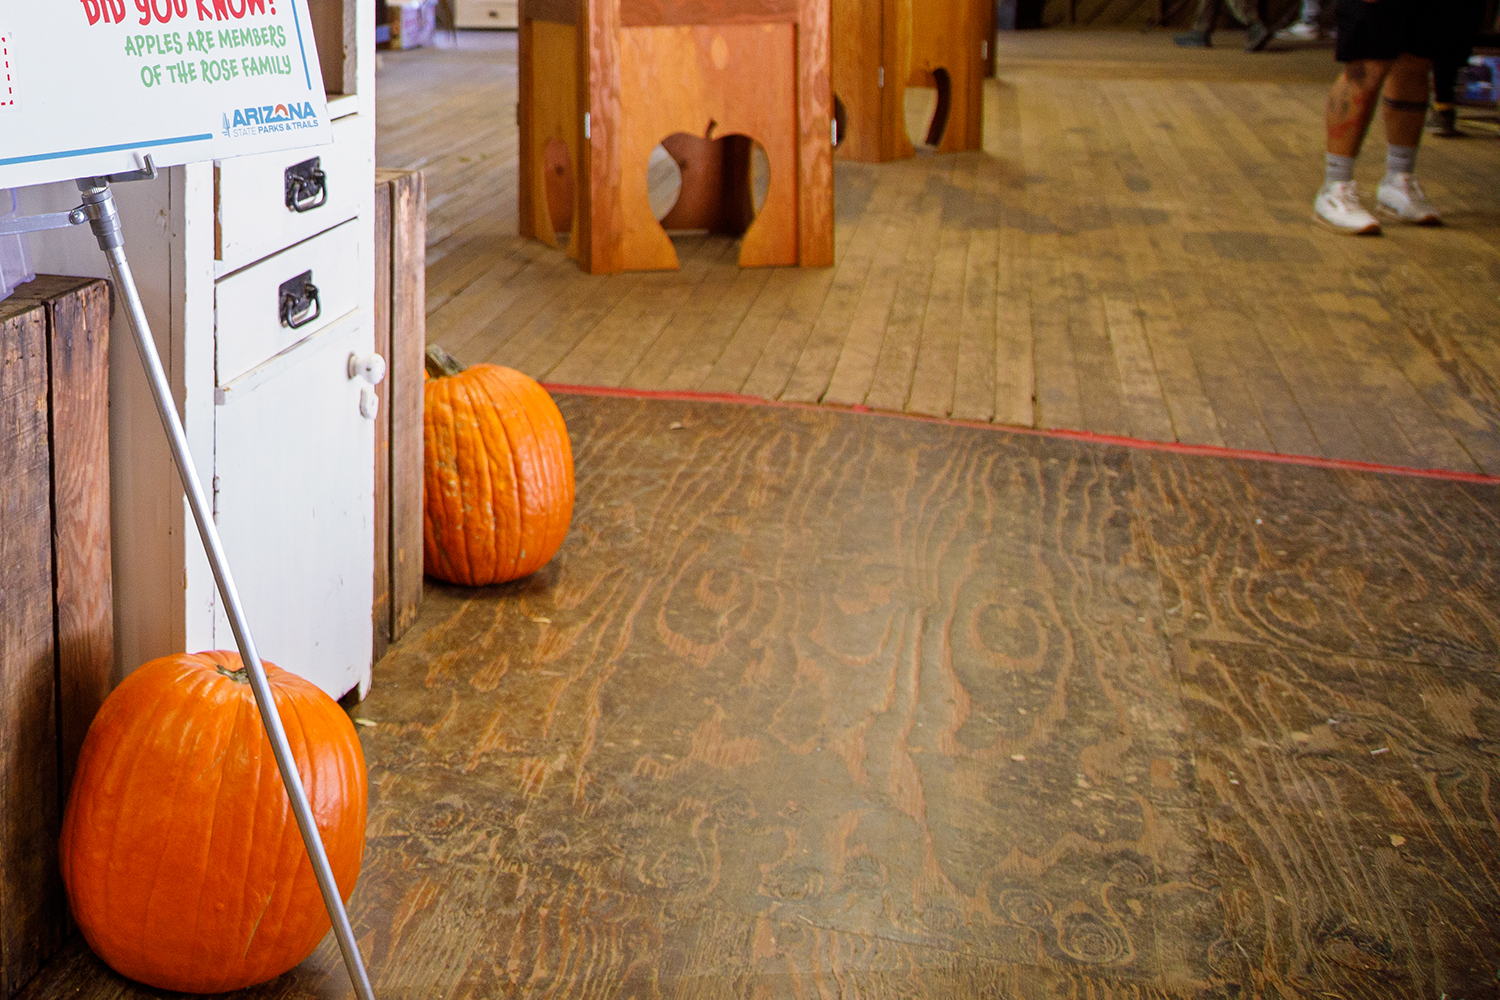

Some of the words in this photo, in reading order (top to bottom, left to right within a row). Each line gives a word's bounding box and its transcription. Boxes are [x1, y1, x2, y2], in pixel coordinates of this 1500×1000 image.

[124, 31, 184, 57] APPLES
[186, 28, 215, 55] ARE
[218, 24, 288, 50] MEMBERS
[141, 63, 162, 88] OF
[166, 61, 199, 85] THE
[200, 56, 240, 85] ROSE
[241, 53, 292, 78] FAMILY
[233, 101, 317, 128] ARIZONA
[233, 127, 257, 138] STATE
[258, 123, 285, 134] PARKS
[285, 121, 292, 131] &
[292, 119, 319, 130] TRAILS
